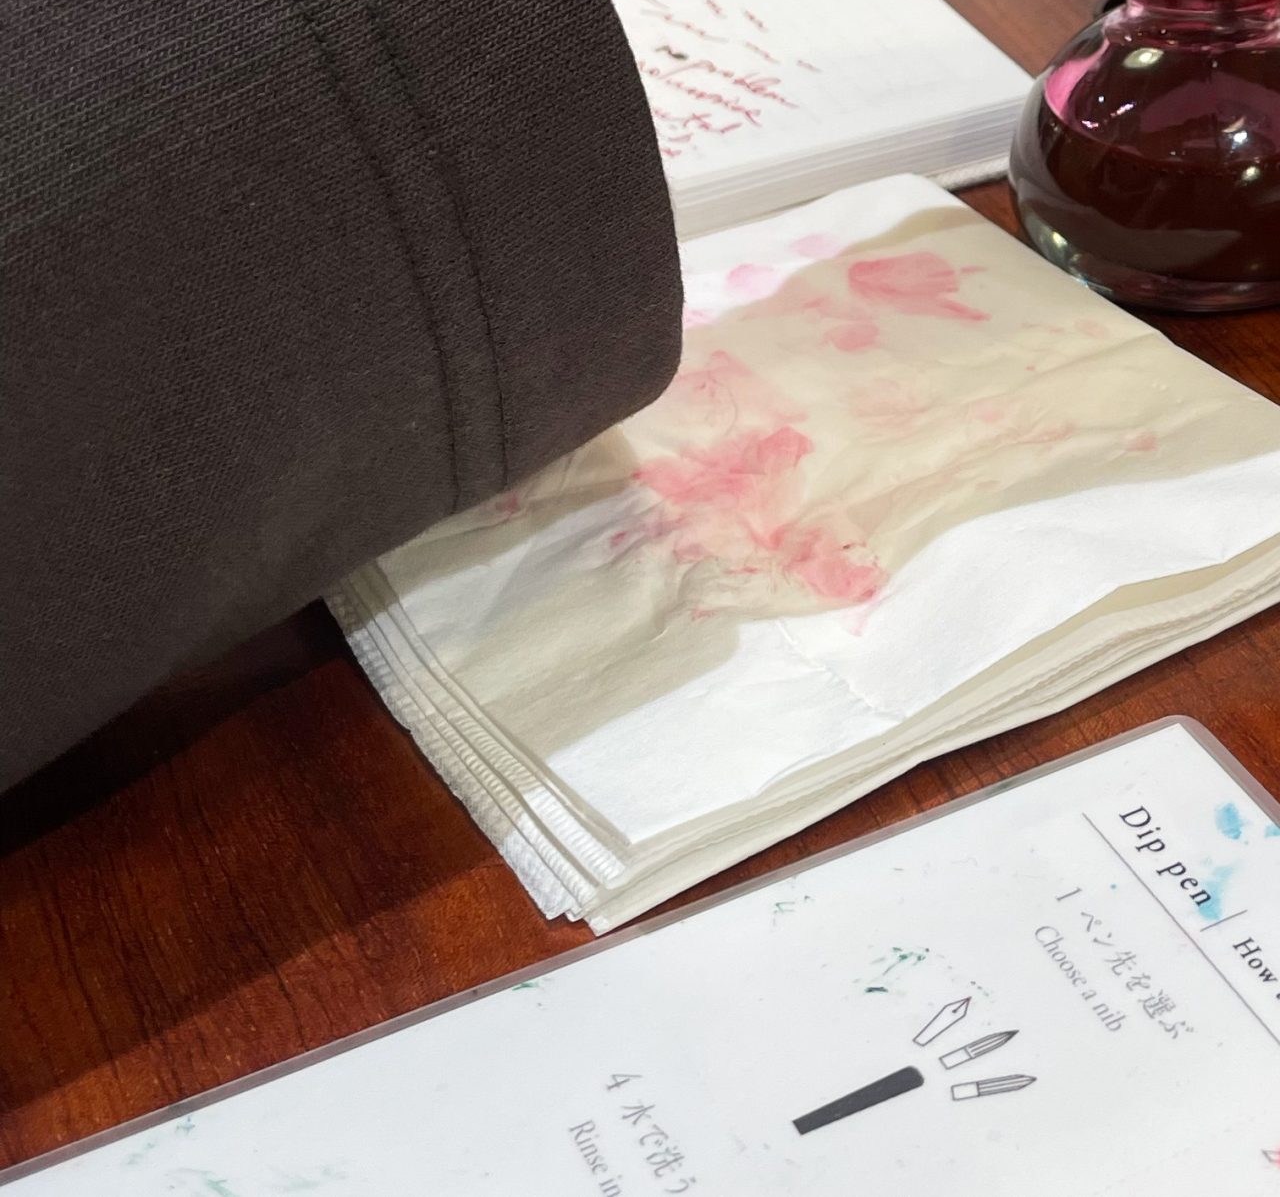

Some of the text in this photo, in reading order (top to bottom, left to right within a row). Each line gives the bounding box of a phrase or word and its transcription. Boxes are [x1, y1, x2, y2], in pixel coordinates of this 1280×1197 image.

[1118, 805, 1212, 908] Dip pen
[1034, 925, 1127, 1033] Choose a nib
[1080, 910, 1195, 1040] ペン先を選ぶ
[1232, 936, 1278, 984] How
[568, 1118, 609, 1176] Rinse
[606, 1073, 697, 1194] 4 水で洗う
